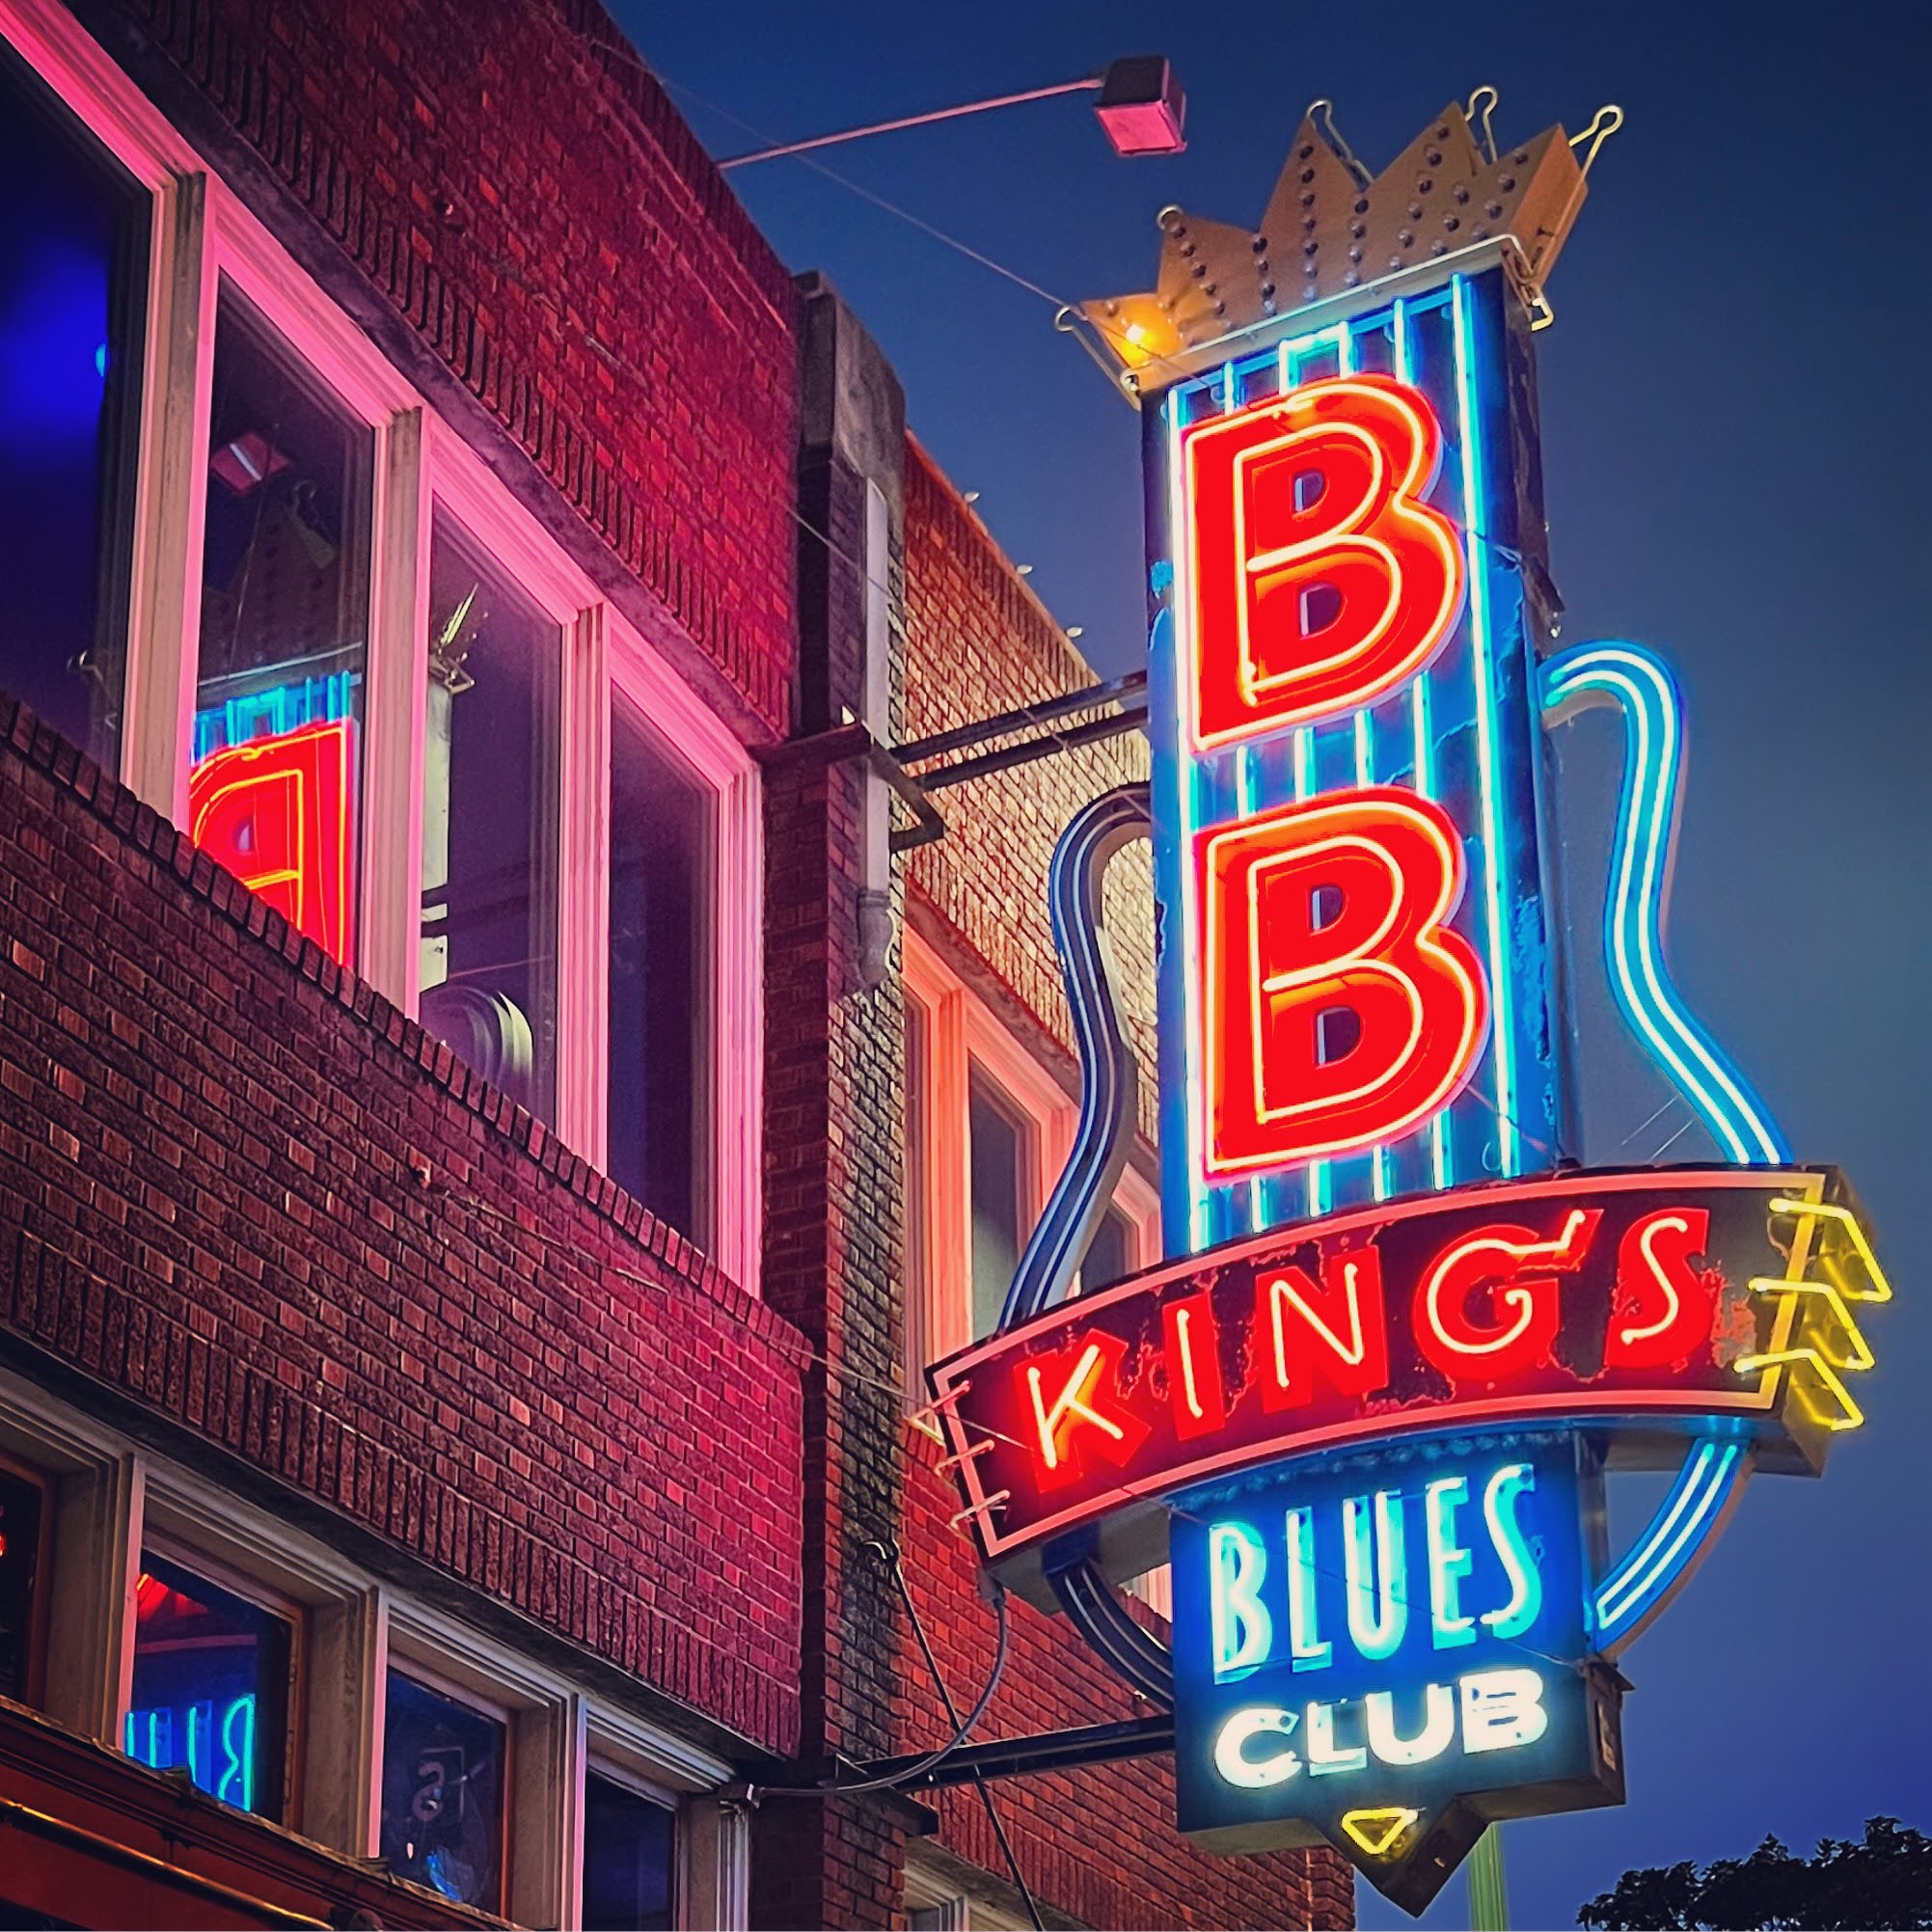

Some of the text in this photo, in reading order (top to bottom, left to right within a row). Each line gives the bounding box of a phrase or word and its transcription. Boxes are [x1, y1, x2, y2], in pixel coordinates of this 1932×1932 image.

[1181, 373, 1467, 757] B
[1193, 784, 1491, 1186] B
[1013, 1208, 1713, 1493] KING'S
[1209, 1463, 1543, 1685] BLUES
[1213, 1669, 1548, 1789] CLUB
